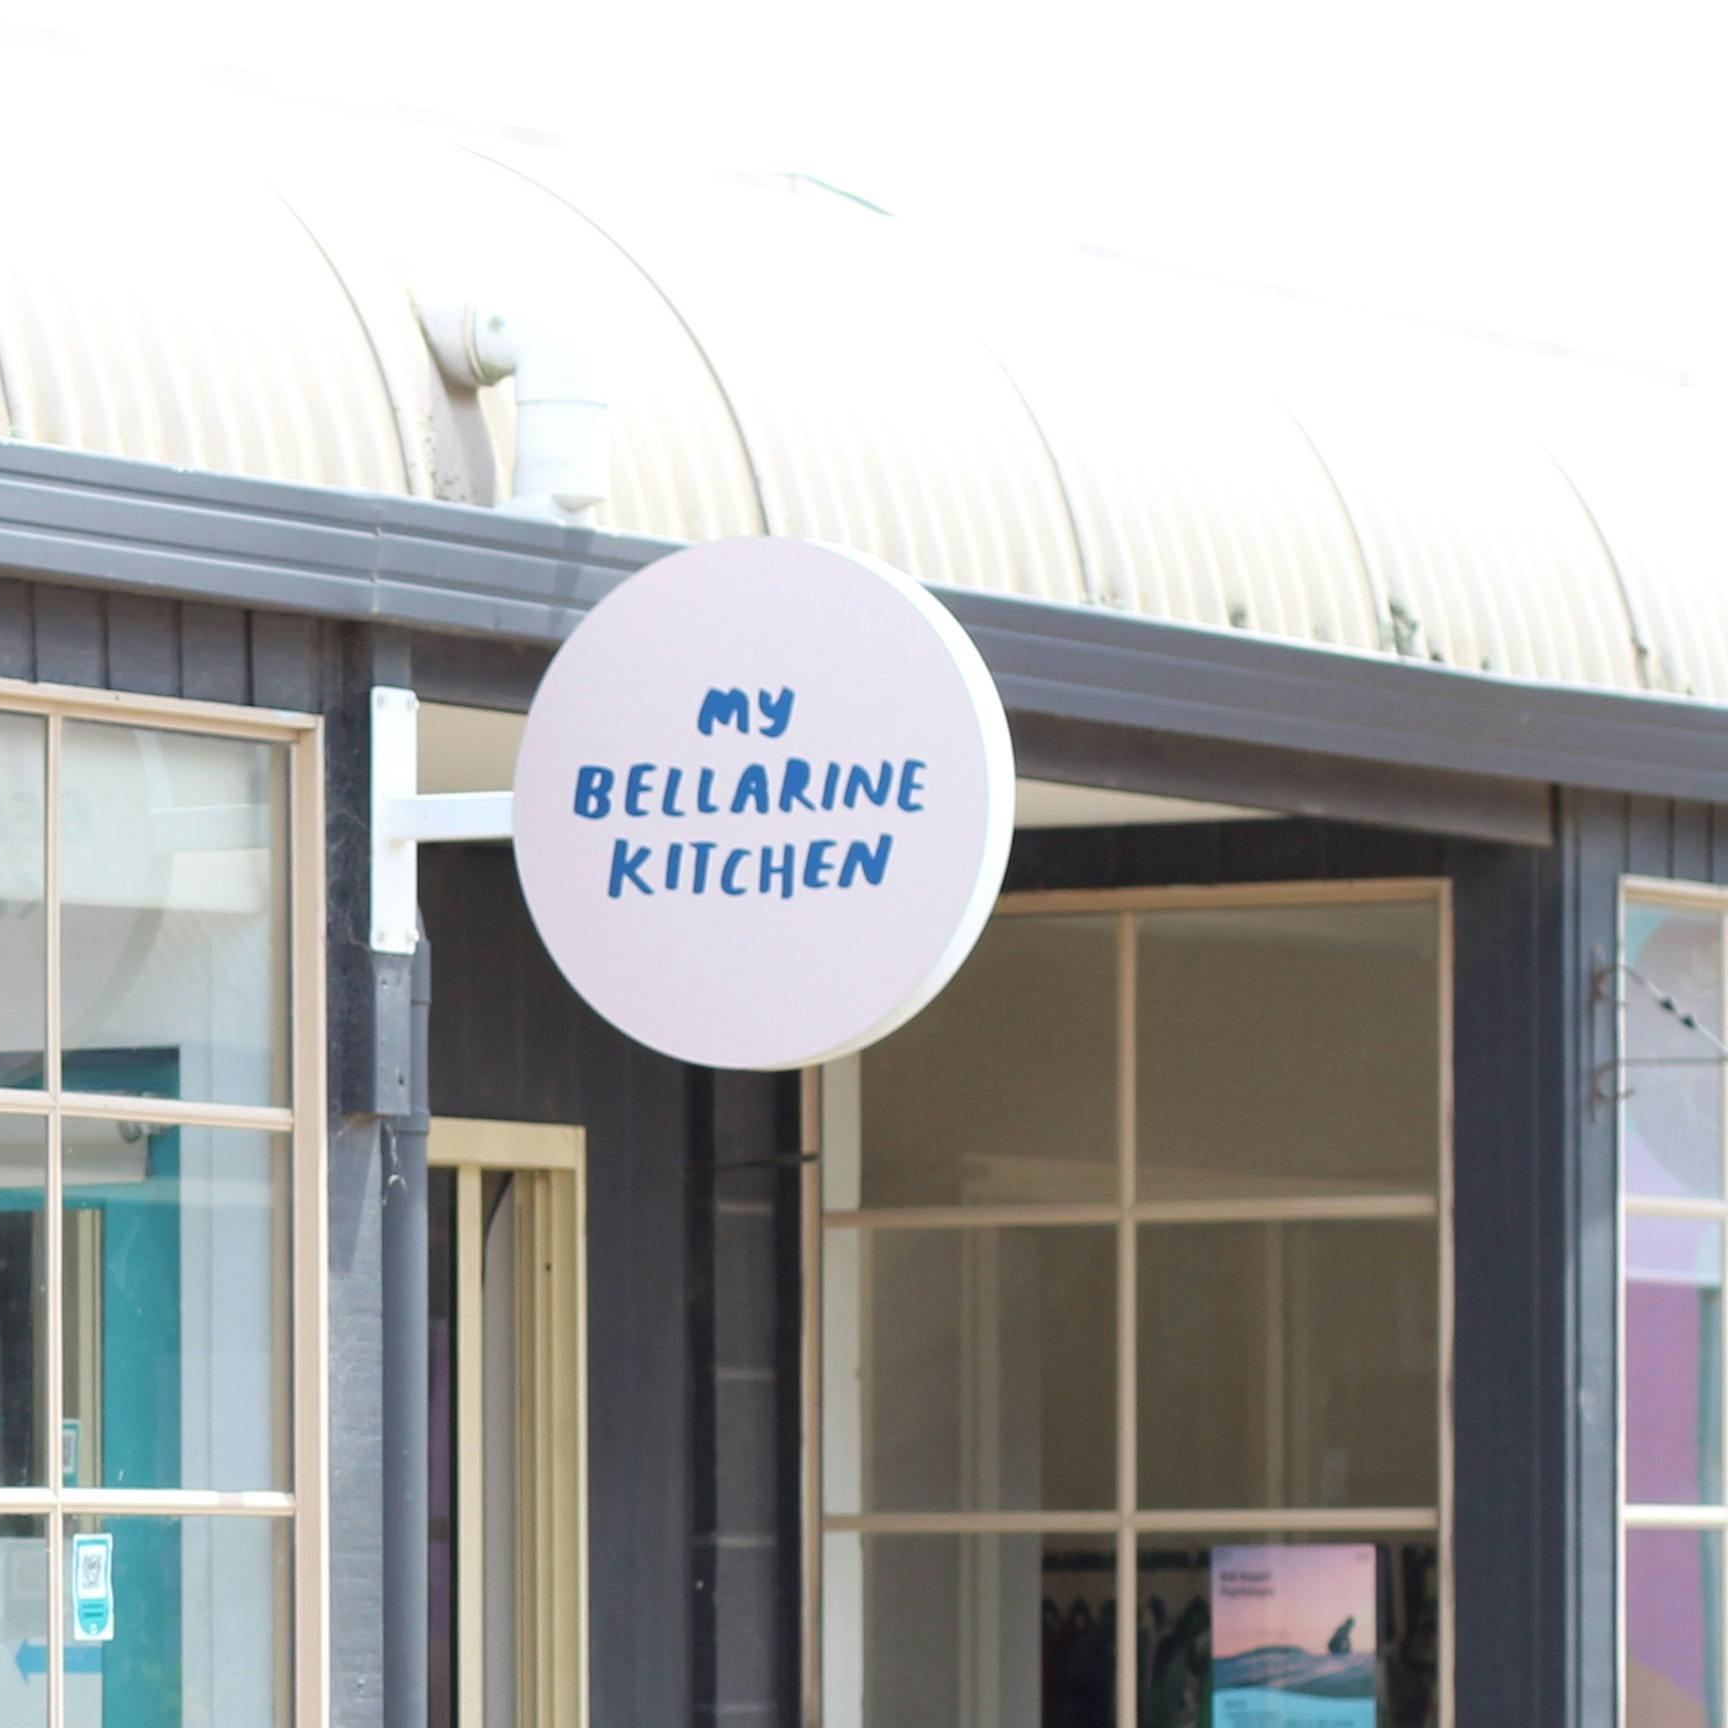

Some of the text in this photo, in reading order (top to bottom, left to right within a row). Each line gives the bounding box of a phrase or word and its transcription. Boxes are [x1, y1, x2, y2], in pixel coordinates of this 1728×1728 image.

[698, 686, 794, 738] MY
[573, 758, 927, 820] BELLARINE
[608, 834, 893, 899] KITCHEN
